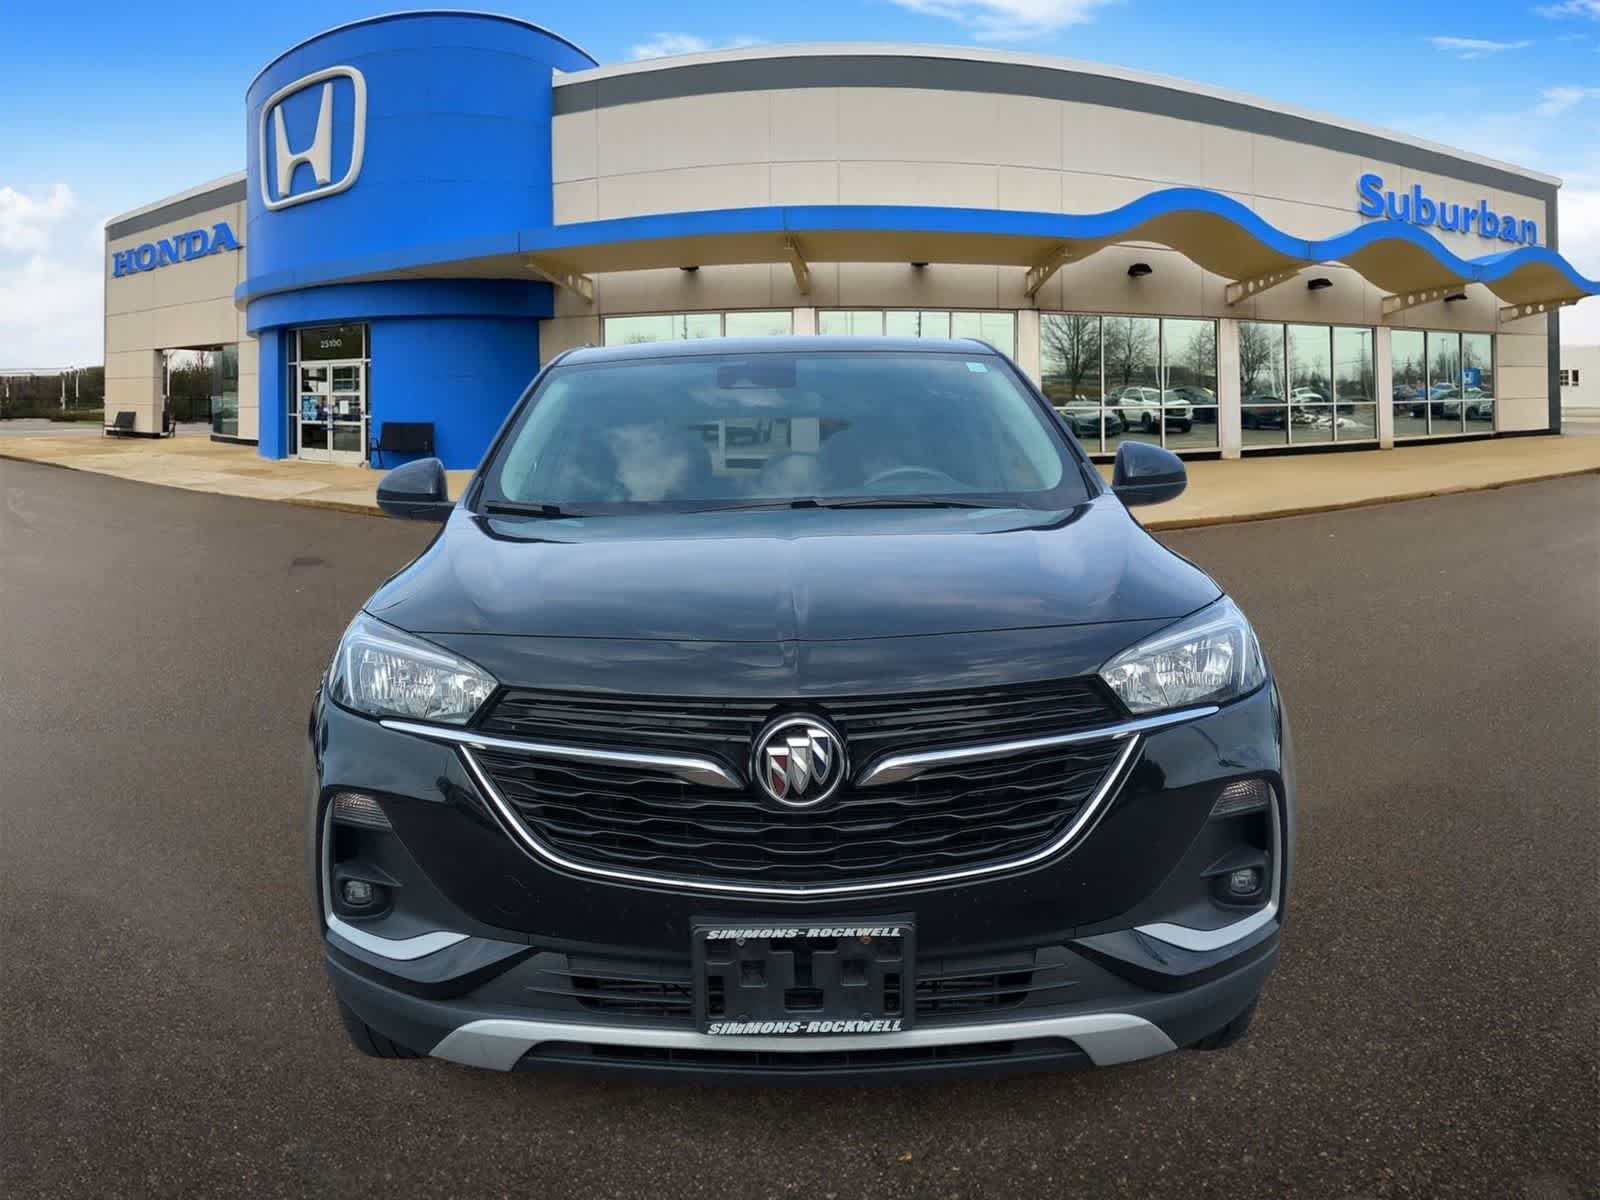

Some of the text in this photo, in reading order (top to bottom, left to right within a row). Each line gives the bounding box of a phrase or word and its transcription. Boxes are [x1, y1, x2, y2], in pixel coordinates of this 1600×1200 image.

[1358, 173, 1538, 246] Suburban
[112, 221, 241, 278] HONDA
[706, 927, 901, 940] SIMMONS-ROCKWELL
[707, 1019, 902, 1035] SIMMONS-ROCKWELL
